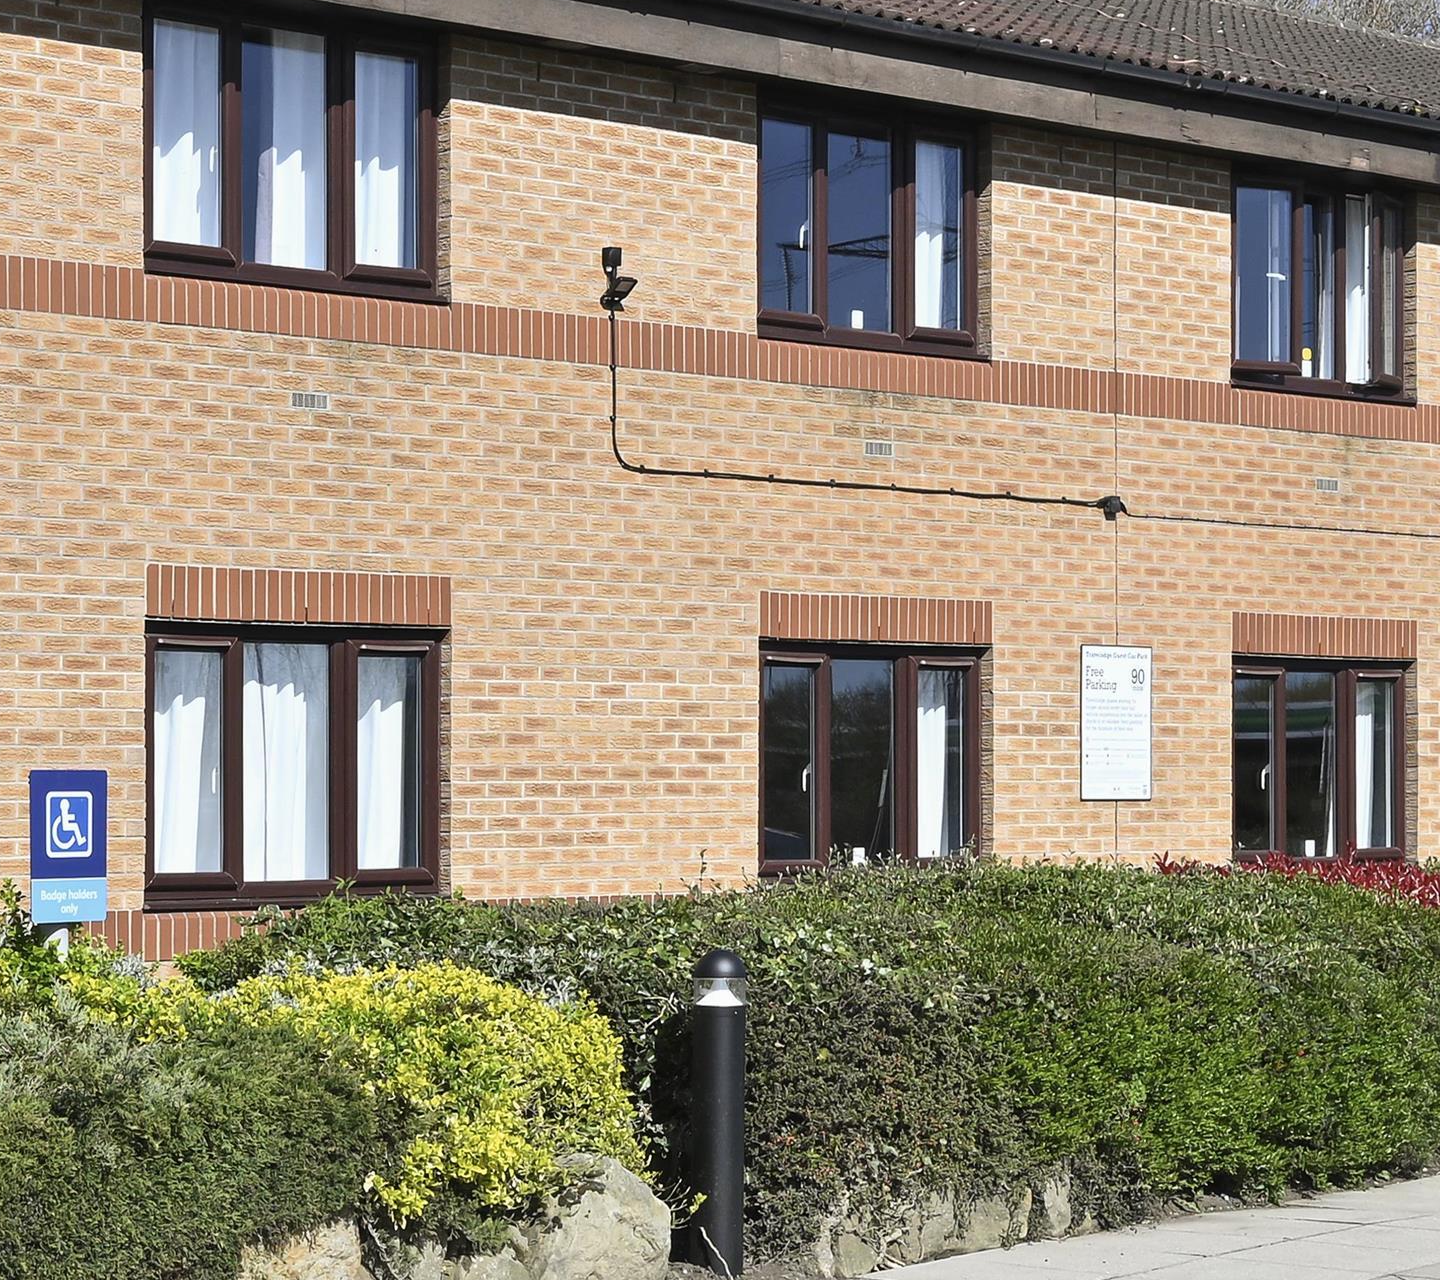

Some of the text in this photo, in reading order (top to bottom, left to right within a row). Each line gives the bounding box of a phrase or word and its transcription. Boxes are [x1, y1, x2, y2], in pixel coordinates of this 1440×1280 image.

[1086, 665, 1104, 677] Free
[1131, 668, 1145, 685] 90
[1086, 678, 1118, 694] Parking
[40, 888, 97, 903] Badge holders
[60, 903, 78, 916] only
